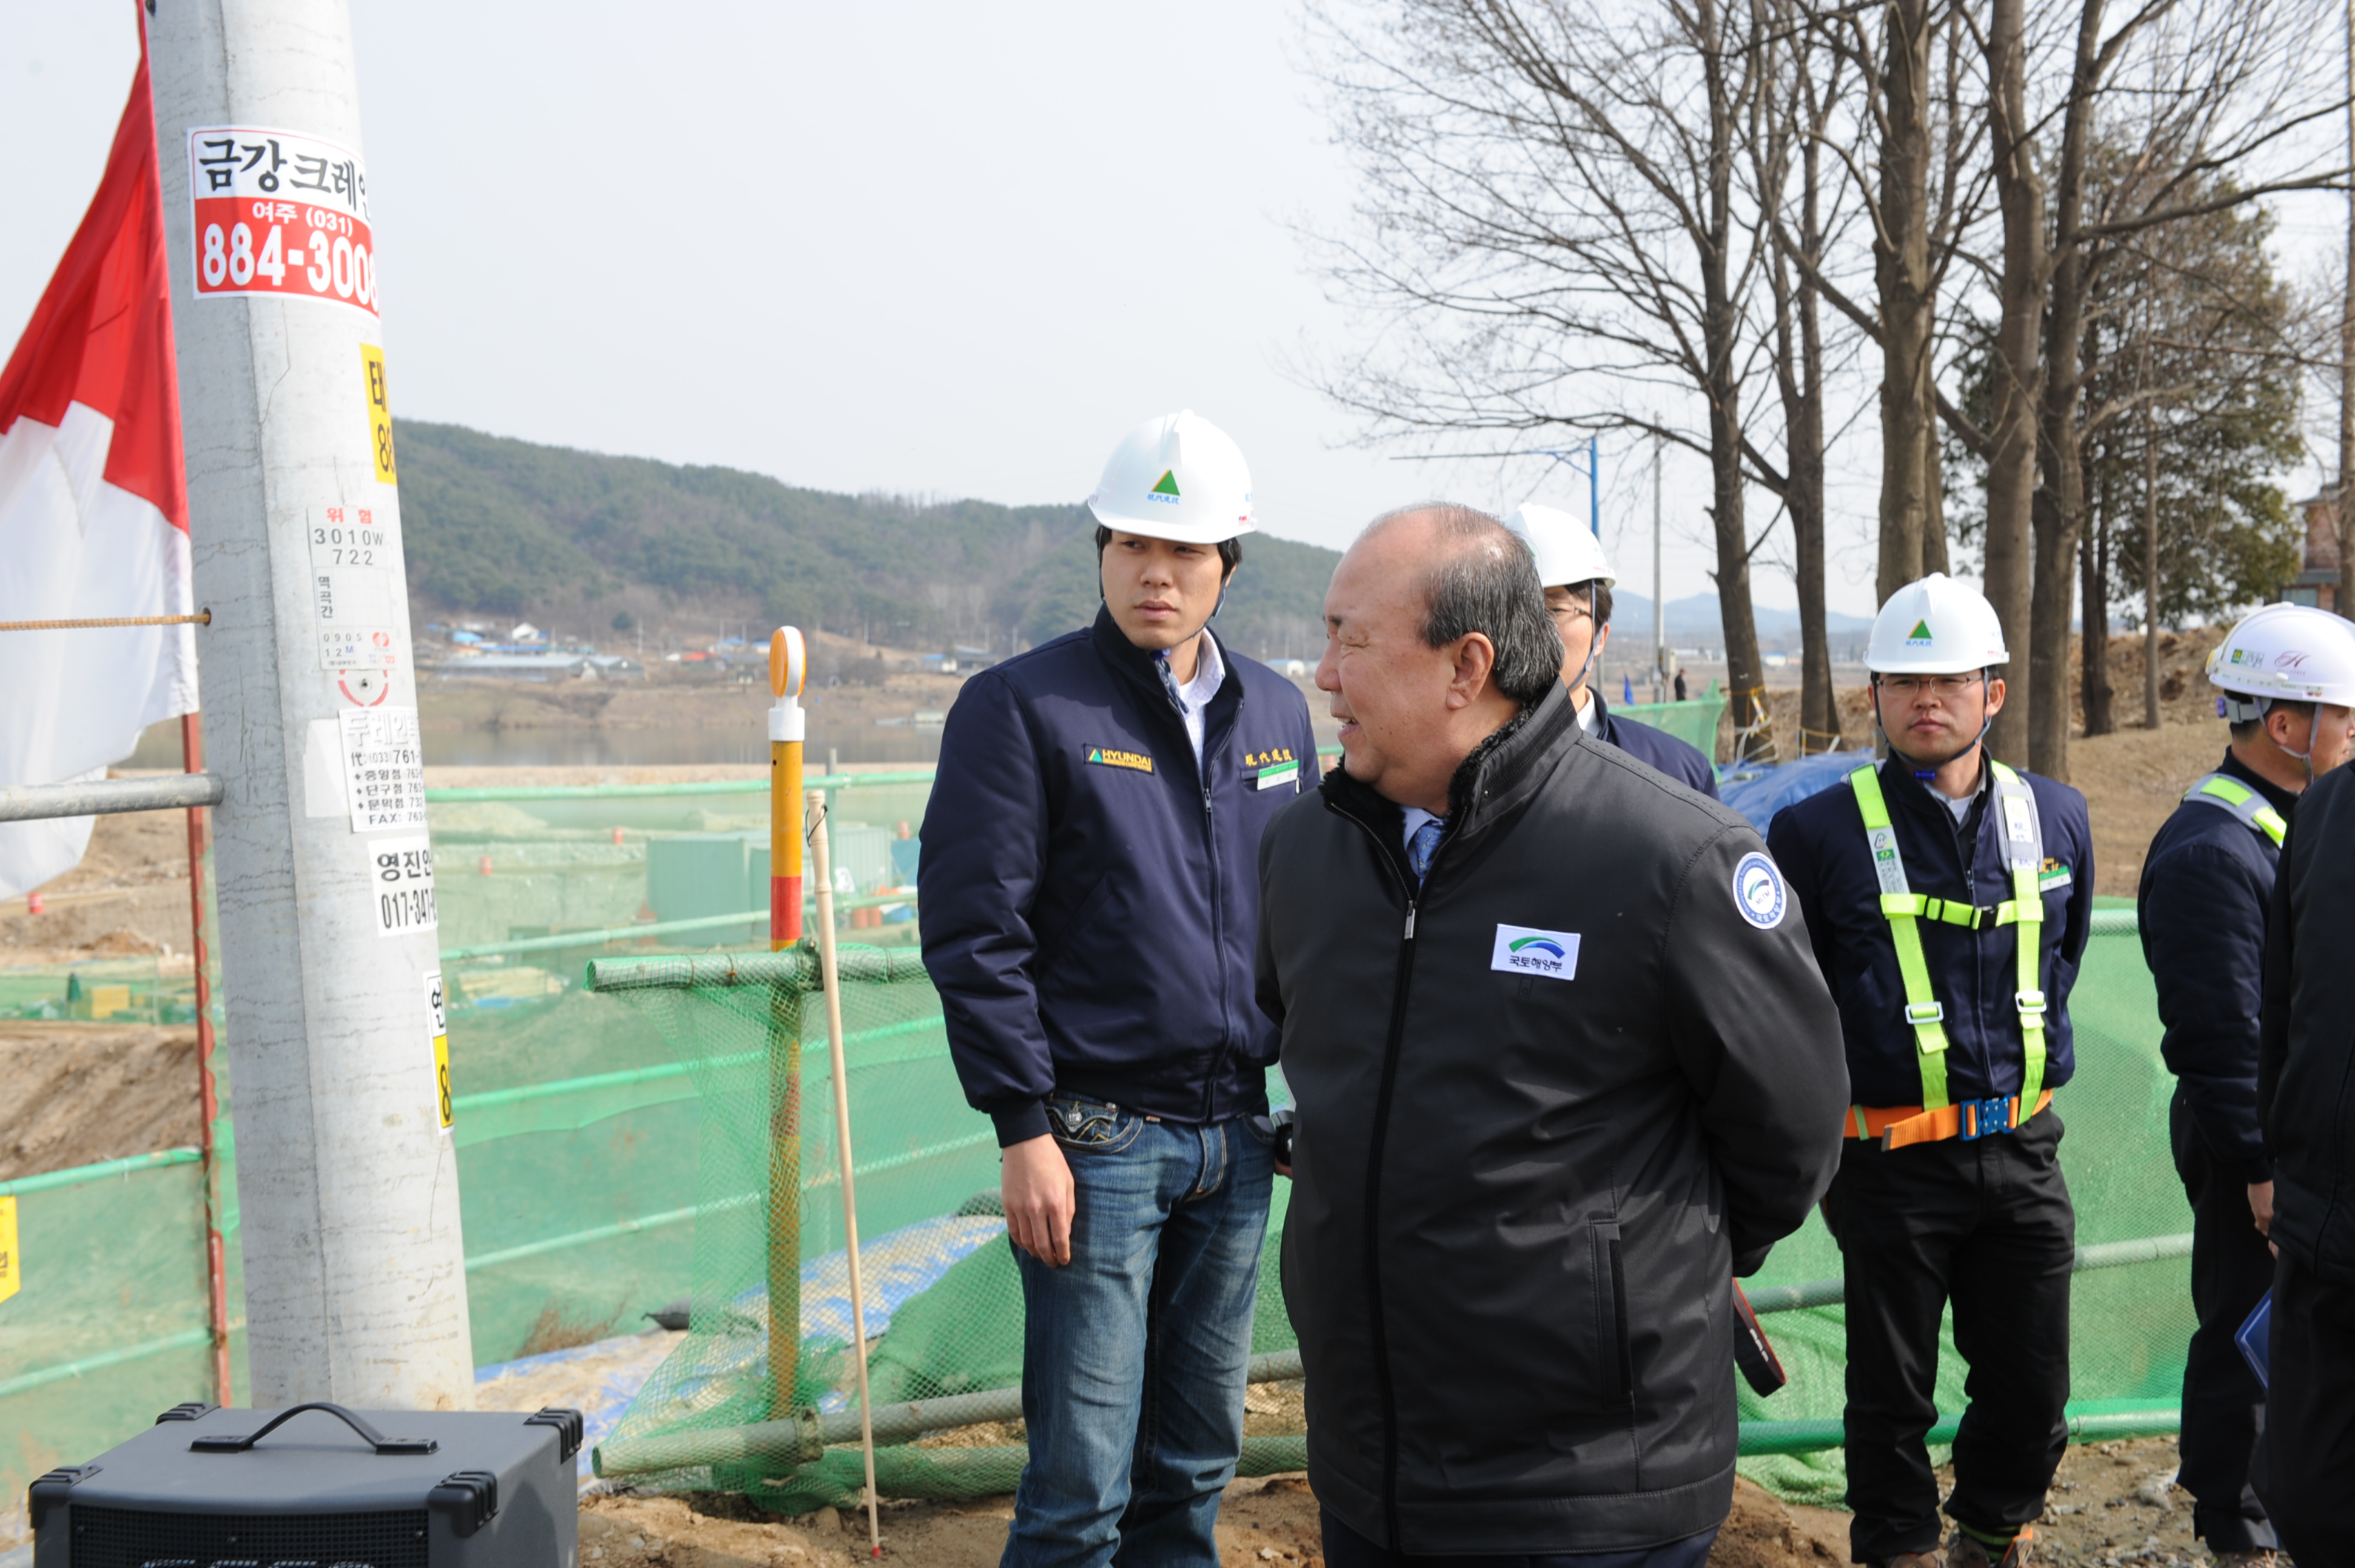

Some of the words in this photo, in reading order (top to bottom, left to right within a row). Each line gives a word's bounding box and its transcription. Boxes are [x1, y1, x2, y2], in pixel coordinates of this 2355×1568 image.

[252, 201, 297, 224] 여주
[305, 206, 354, 238] (031)
[368, 360, 388, 413] 태
[332, 549, 374, 566] 722
[1102, 748, 1152, 767] HYUNDAI
[1509, 954, 1563, 973] 국토해양부
